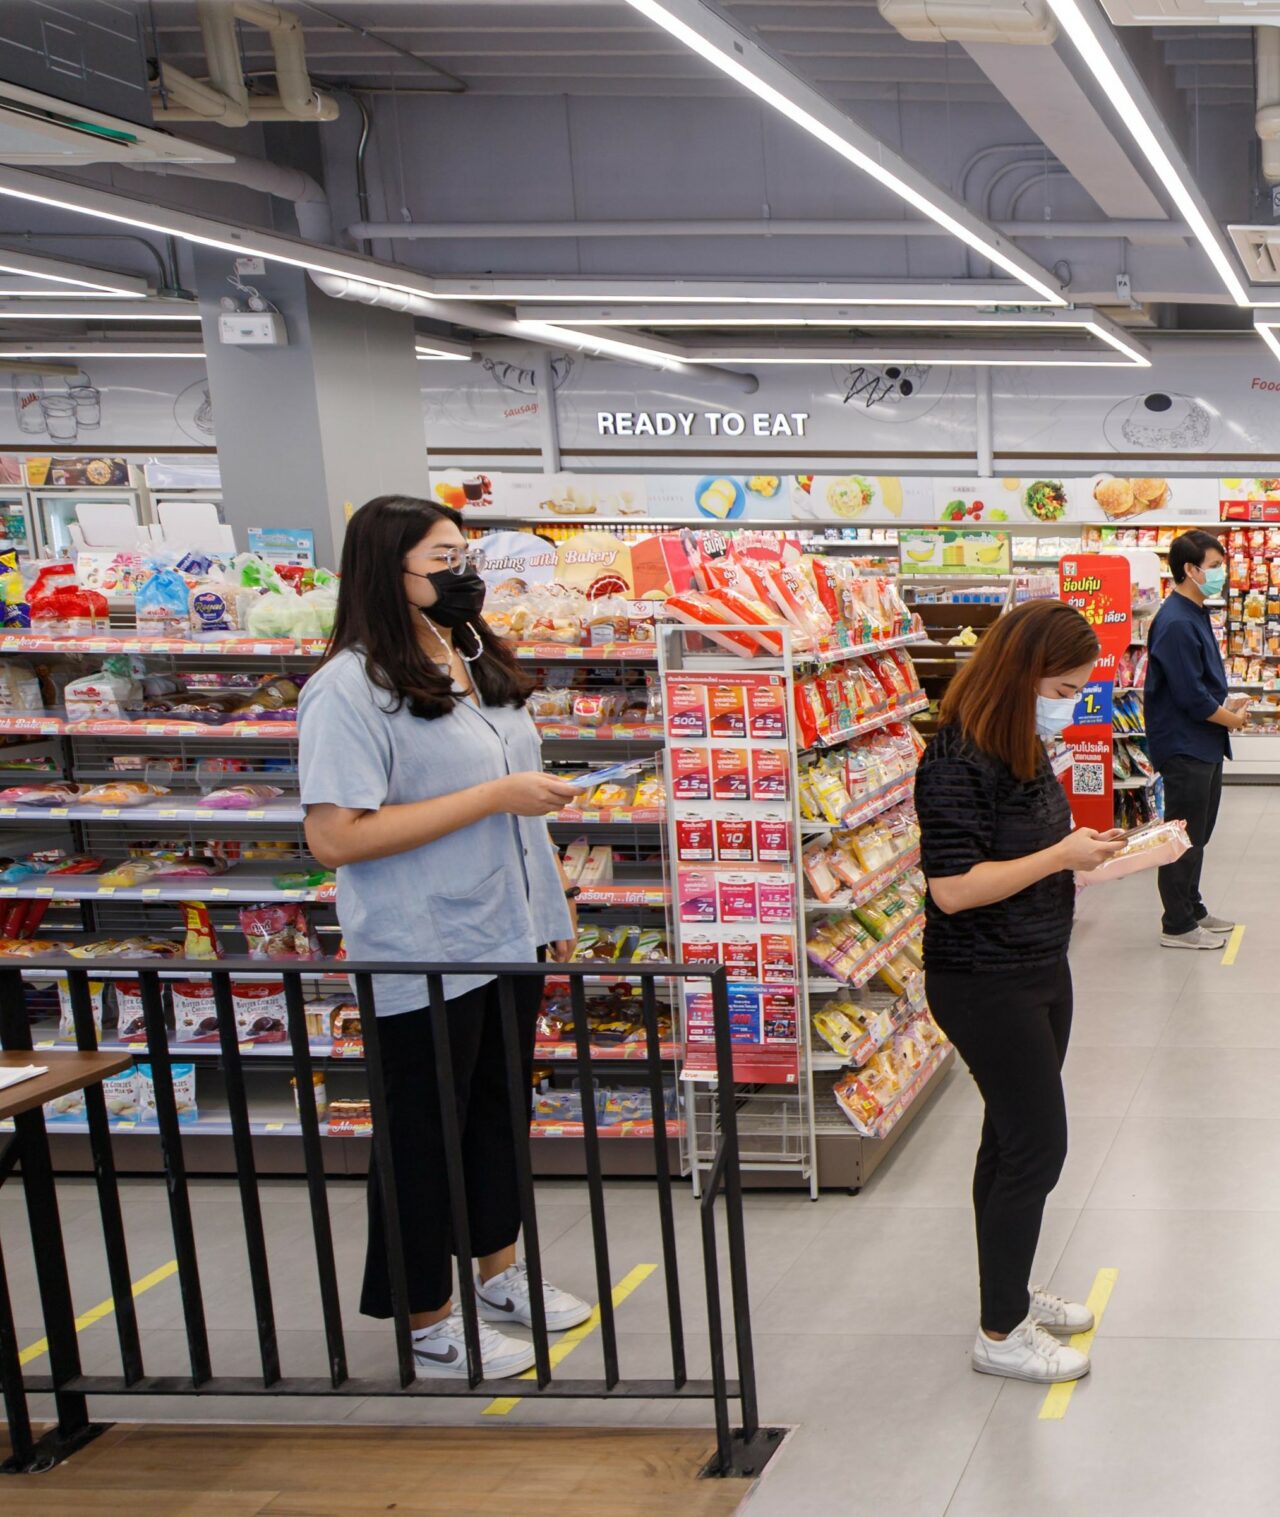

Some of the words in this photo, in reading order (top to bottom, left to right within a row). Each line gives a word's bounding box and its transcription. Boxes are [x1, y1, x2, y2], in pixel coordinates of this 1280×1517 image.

[504, 402, 539, 418] sausag
[597, 412, 695, 436] READY
[705, 413, 746, 436] TO
[753, 413, 808, 436] EAT
[484, 554, 526, 572] orning
[529, 551, 559, 568] with
[565, 549, 619, 571] Bakery
[689, 832, 701, 843] 5
[726, 832, 744, 843] 10
[766, 833, 781, 844] 15
